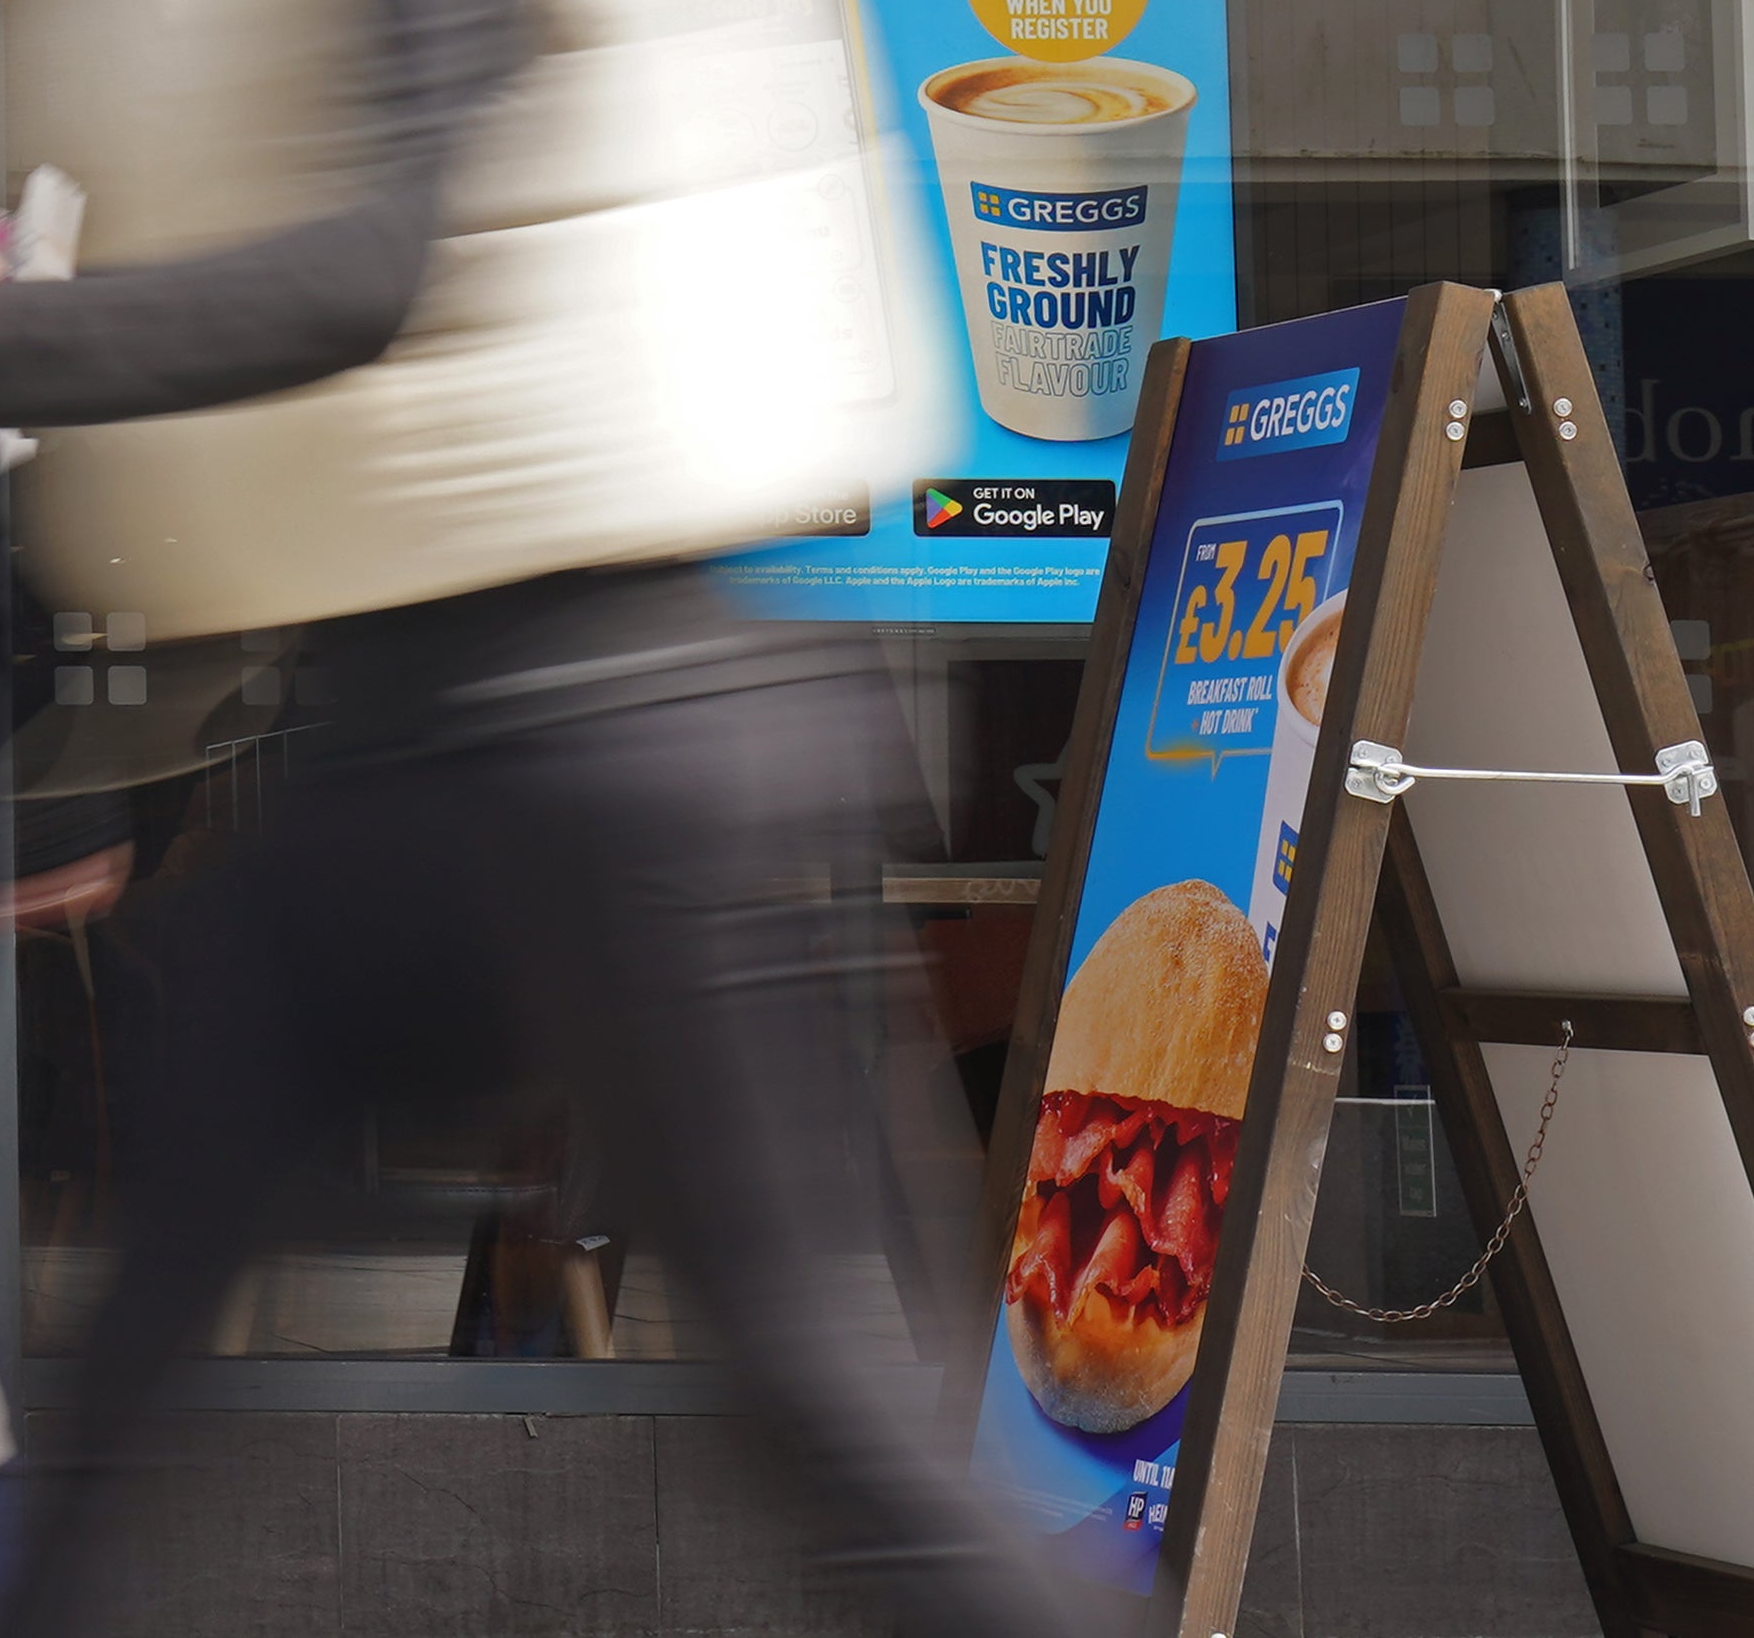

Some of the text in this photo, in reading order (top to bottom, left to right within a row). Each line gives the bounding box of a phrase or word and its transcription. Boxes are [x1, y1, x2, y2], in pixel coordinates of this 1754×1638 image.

[1010, 17, 1109, 40] REGISTER
[1007, 194, 1141, 224] GREGGS
[980, 241, 1141, 288] FRESHLY
[986, 282, 1136, 329] GROUND
[991, 320, 1133, 361] FAIRTRADE
[995, 354, 1129, 398] FLAVOUR
[1250, 384, 1350, 445] GREGGS
[973, 488, 1035, 500] GET IT ON
[795, 504, 857, 524] Store
[973, 502, 1105, 531] Google Play
[1196, 543, 1217, 562] FROM
[927, 566, 958, 576] Google
[959, 567, 978, 577] Play
[979, 567, 996, 575] and
[998, 567, 1012, 575] the
[1013, 567, 1044, 577] Google
[1045, 567, 1063, 577] Play
[1086, 568, 1100, 576] are
[934, 578, 956, 587] Logo
[957, 578, 972, 586] are
[974, 578, 1024, 586] trademarks
[1037, 578, 1062, 587] Apple
[1174, 530, 1329, 665] £3.25
[1187, 675, 1273, 706] BREAKFAST ROLL
[1200, 710, 1222, 736] HOT
[1133, 1459, 1159, 1486] UNTIL
[1128, 1496, 1144, 1517] HP
